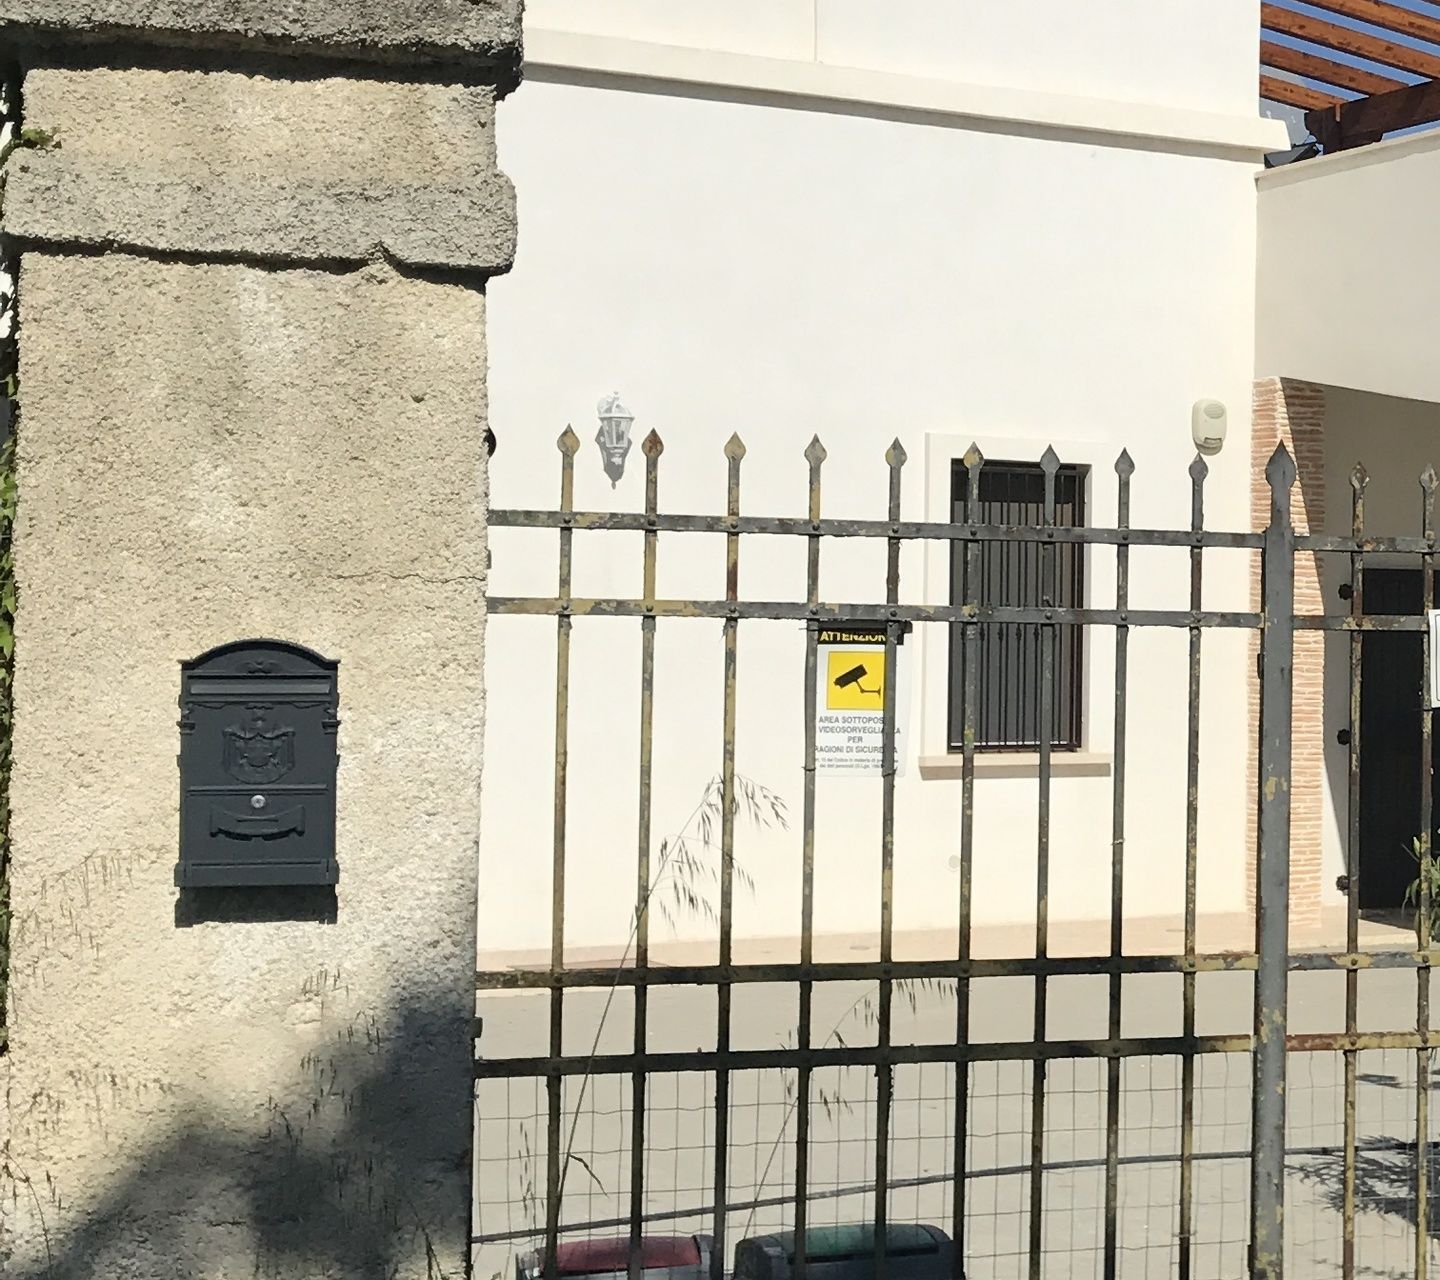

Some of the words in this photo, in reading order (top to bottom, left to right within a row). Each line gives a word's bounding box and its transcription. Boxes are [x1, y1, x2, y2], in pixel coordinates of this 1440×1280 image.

[820, 631, 886, 641] ATTENZION
[819, 716, 840, 724] AREA
[842, 716, 884, 725] SOTTOPOS
[819, 726, 901, 734] VIDEOSORVEGLIA
[847, 736, 863, 744] PER
[855, 746, 897, 754] SICUREA
